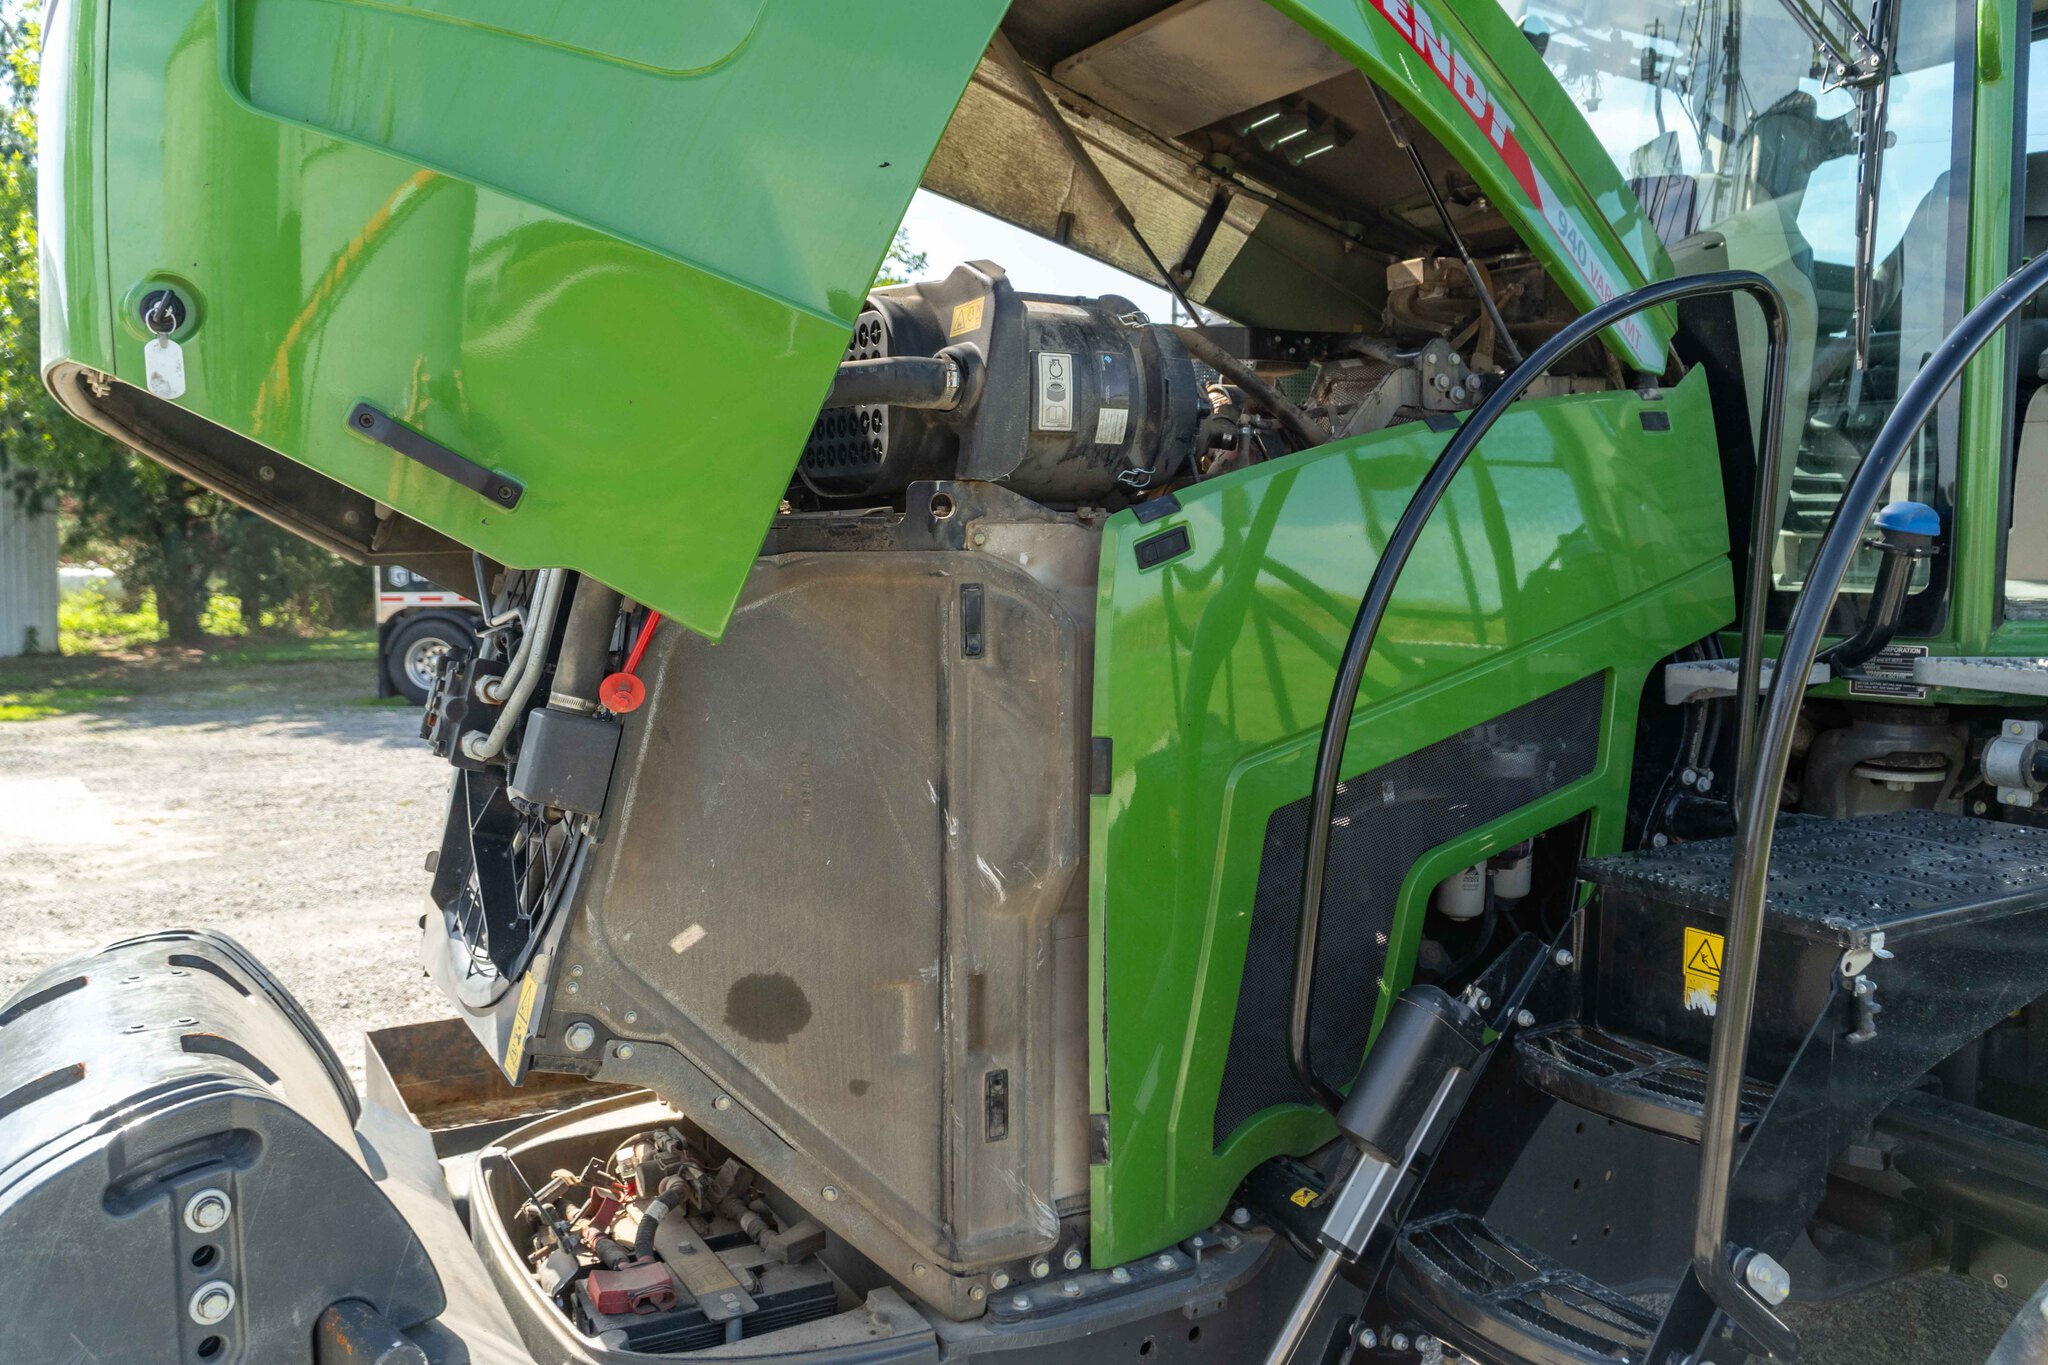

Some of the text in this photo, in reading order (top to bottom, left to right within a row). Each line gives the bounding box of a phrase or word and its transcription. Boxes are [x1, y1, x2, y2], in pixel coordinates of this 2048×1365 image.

[1382, 0, 1516, 150] ENDT
[1558, 209, 1642, 348] 940 VAR MT
